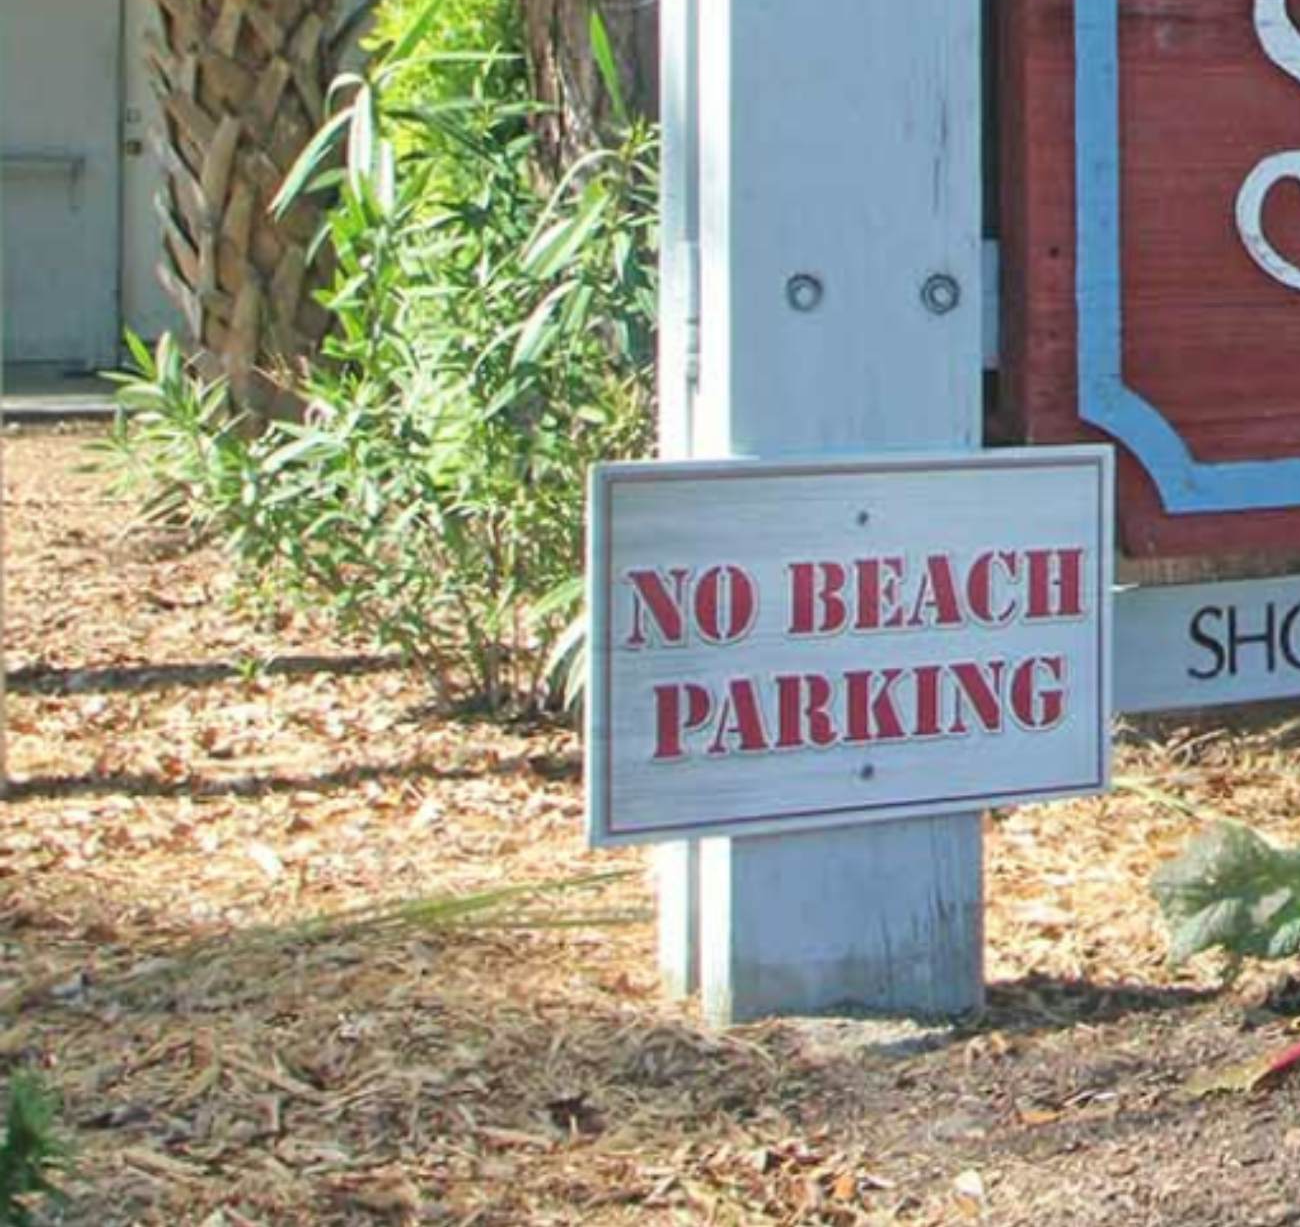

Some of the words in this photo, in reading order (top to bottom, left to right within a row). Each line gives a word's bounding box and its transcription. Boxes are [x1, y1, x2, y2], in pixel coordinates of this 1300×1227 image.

[625, 563, 758, 646] NO
[785, 546, 1085, 636] BEACH
[652, 654, 1065, 760] PARKING
